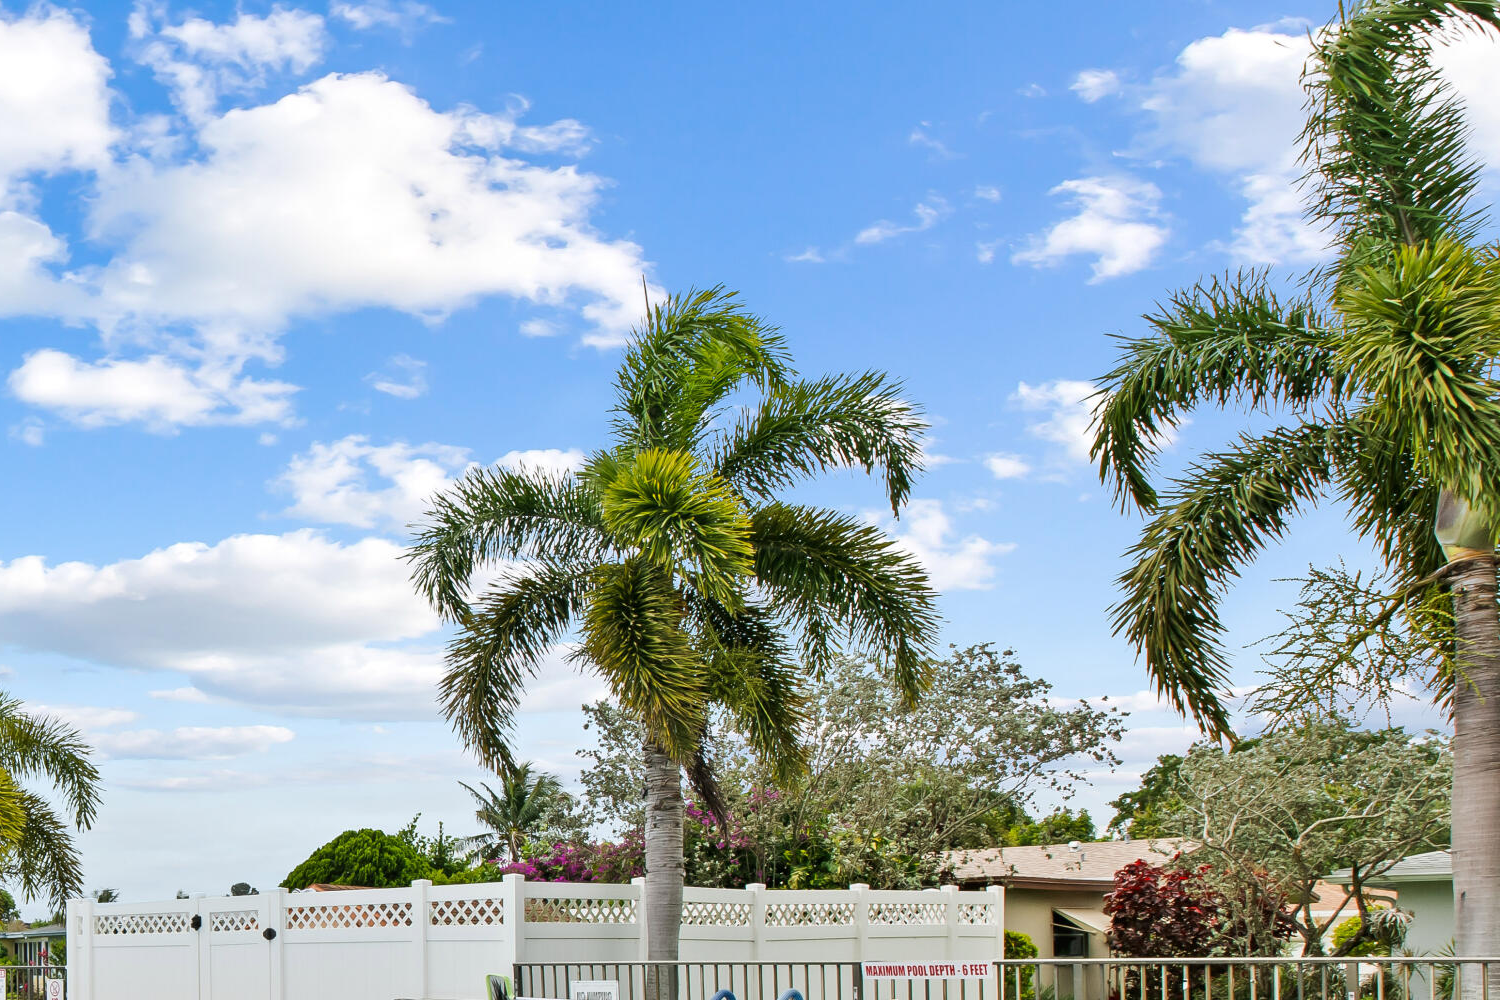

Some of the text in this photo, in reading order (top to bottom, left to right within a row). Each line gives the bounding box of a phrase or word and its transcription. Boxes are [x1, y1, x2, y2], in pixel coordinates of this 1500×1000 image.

[865, 965, 906, 977] MAXIMUM
[907, 965, 928, 977] POOL
[929, 964, 956, 976] DEPTH
[962, 964, 968, 976] 6
[969, 963, 988, 976] FEET
